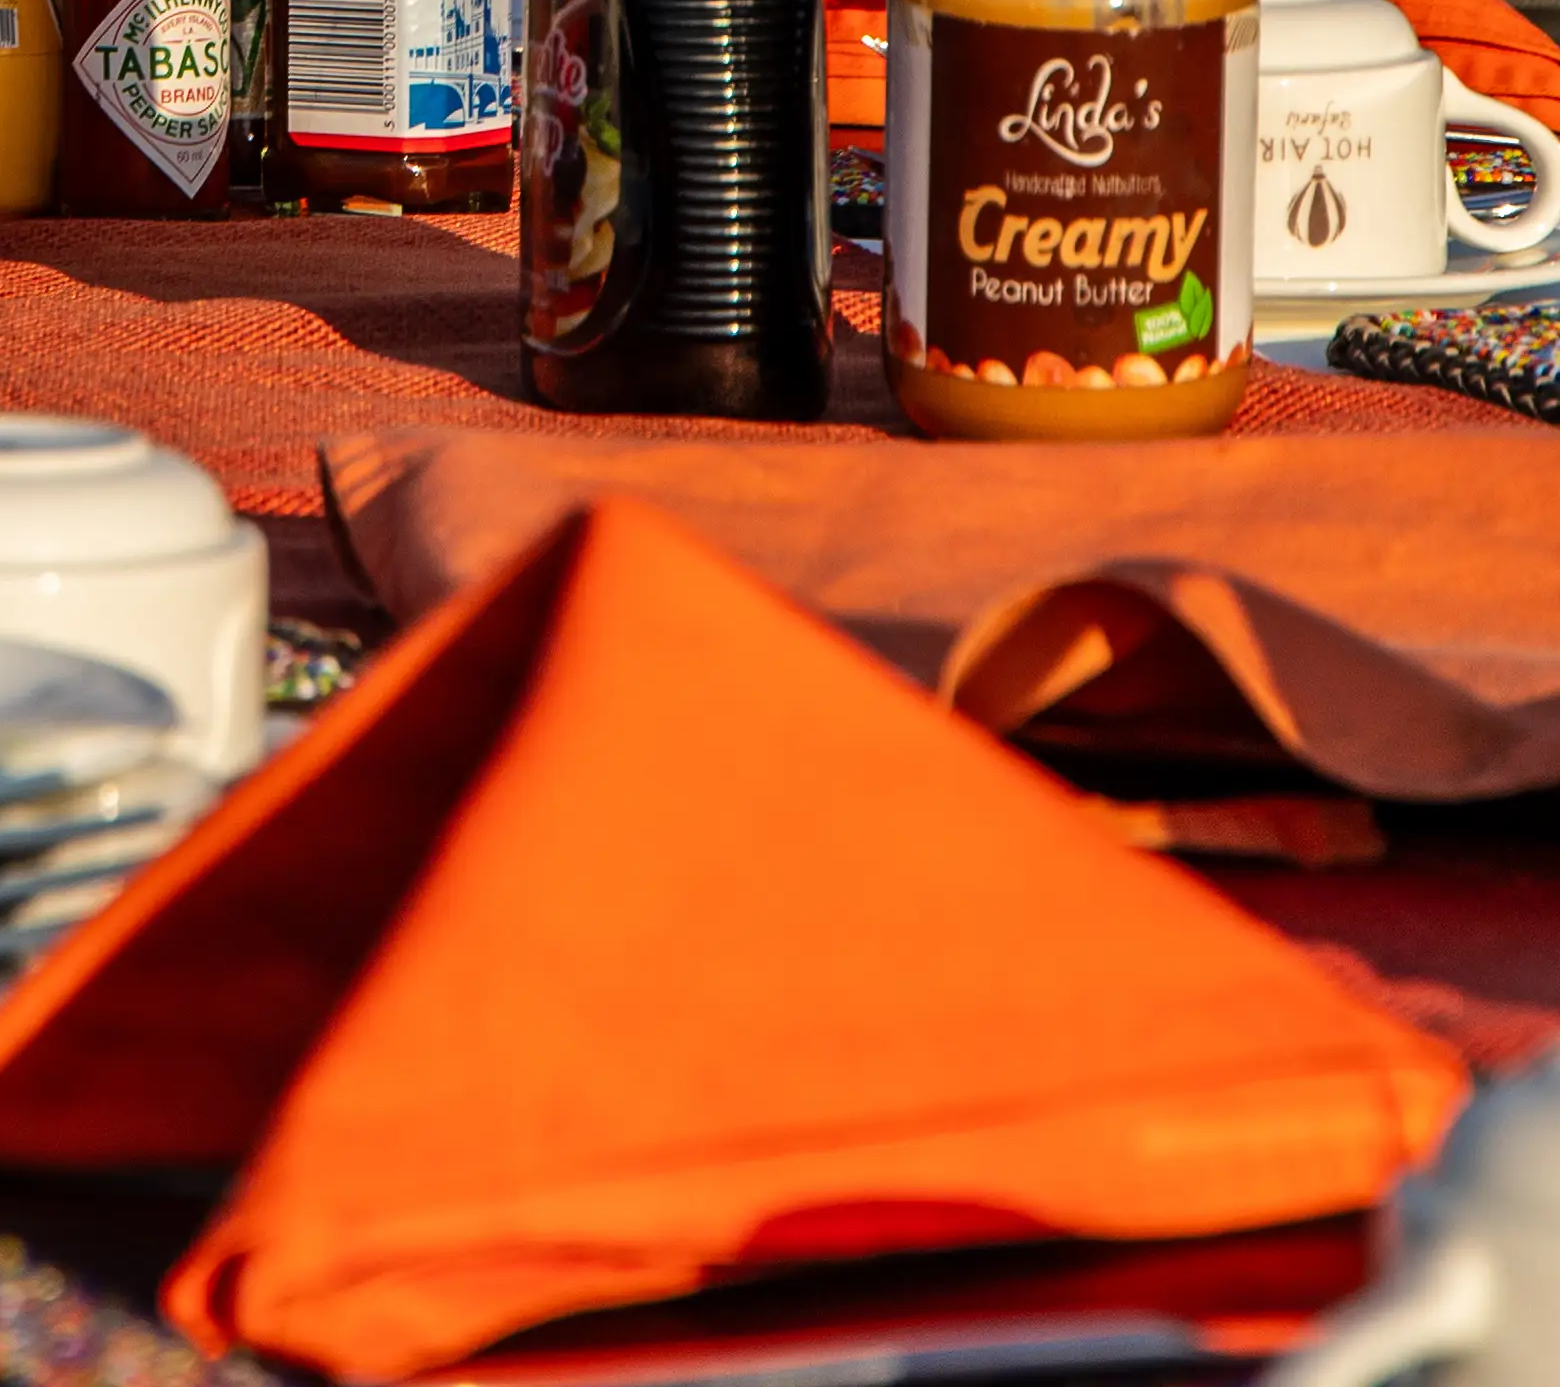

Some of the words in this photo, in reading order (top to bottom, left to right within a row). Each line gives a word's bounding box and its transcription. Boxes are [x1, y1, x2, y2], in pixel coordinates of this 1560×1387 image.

[123, 83, 193, 139] PEPPER
[160, 85, 215, 104] BRAND
[999, 53, 1164, 168] Linda's
[1259, 137, 1311, 162] AIR
[1320, 136, 1372, 161] HOT
[958, 184, 1209, 284] Creamy
[970, 265, 1065, 305] Peanut
[1075, 271, 1155, 306] Butter
